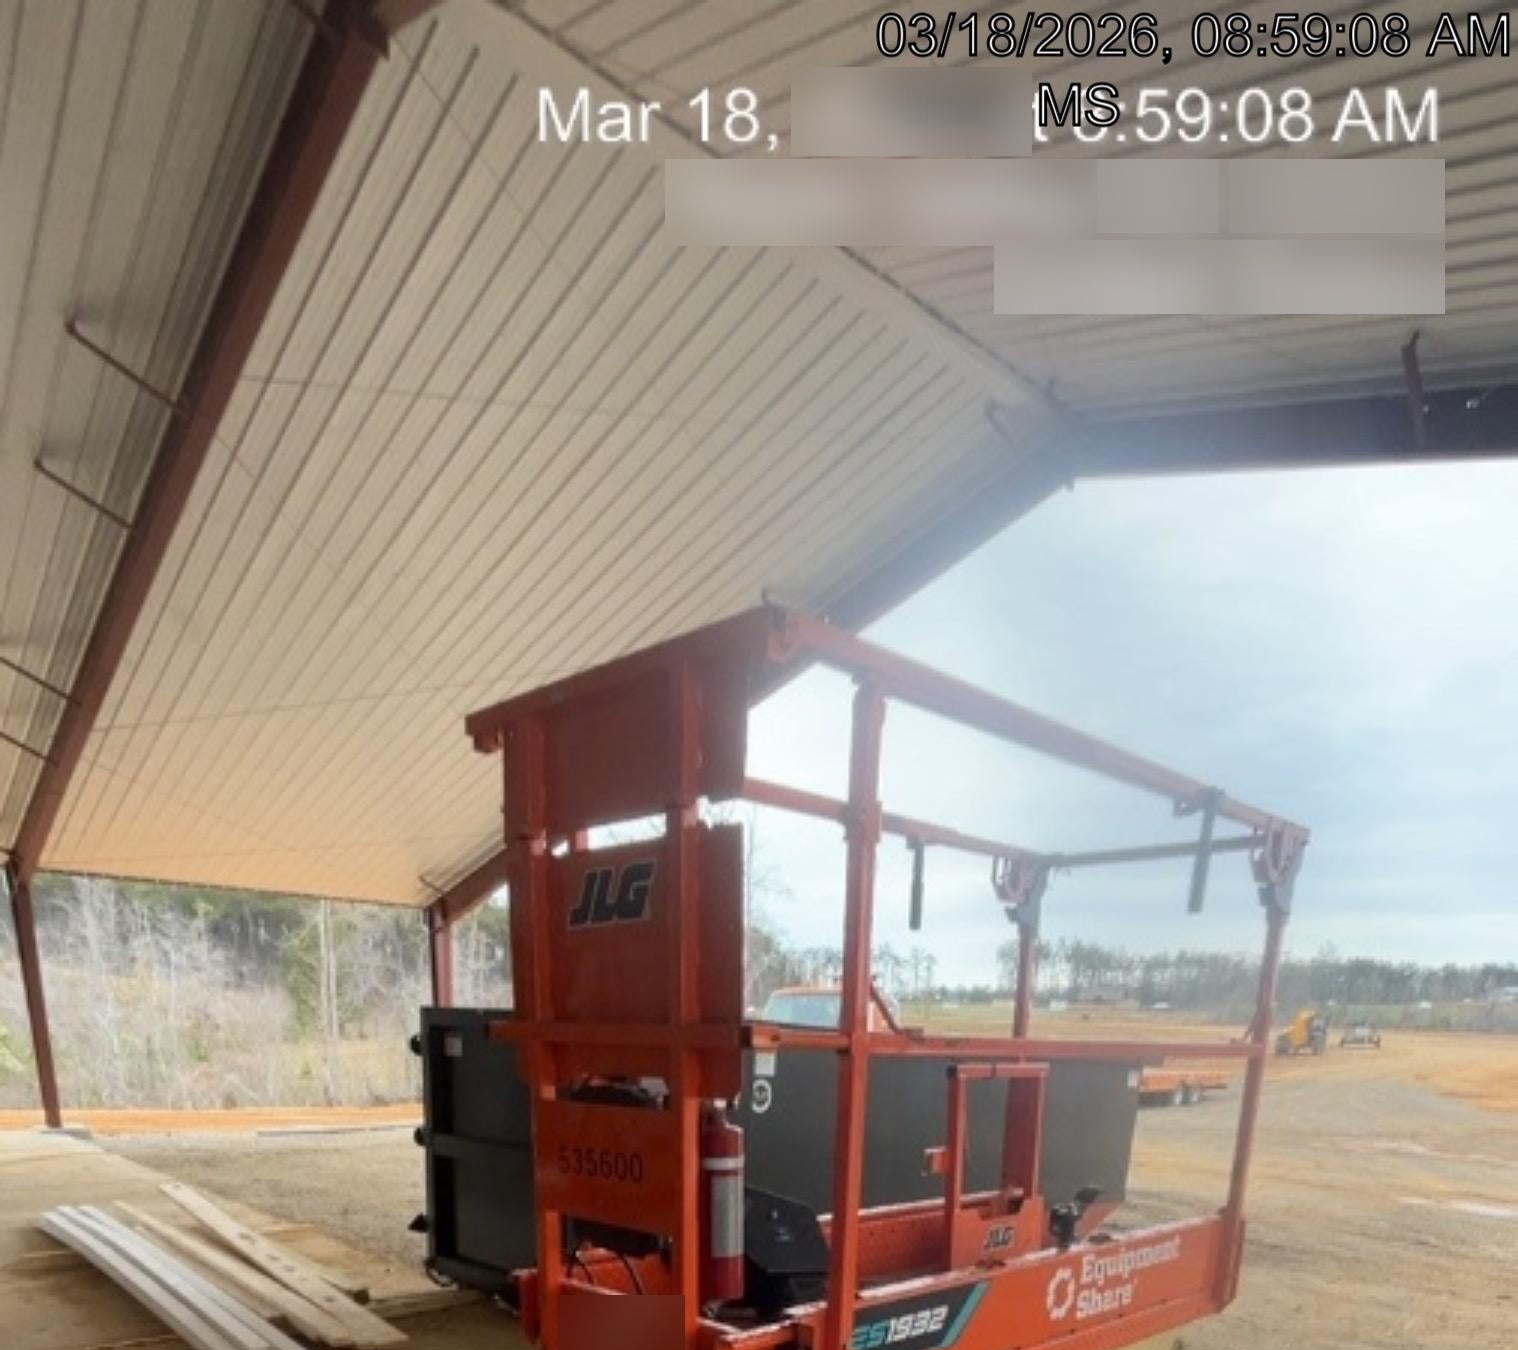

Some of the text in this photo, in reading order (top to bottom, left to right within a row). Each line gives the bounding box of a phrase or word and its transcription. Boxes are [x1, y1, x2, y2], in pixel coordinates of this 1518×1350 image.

[567, 860, 657, 928] JLG
[558, 1144, 643, 1184] 535600
[1079, 1232, 1181, 1287] Equipment
[1075, 1282, 1134, 1321] Share
